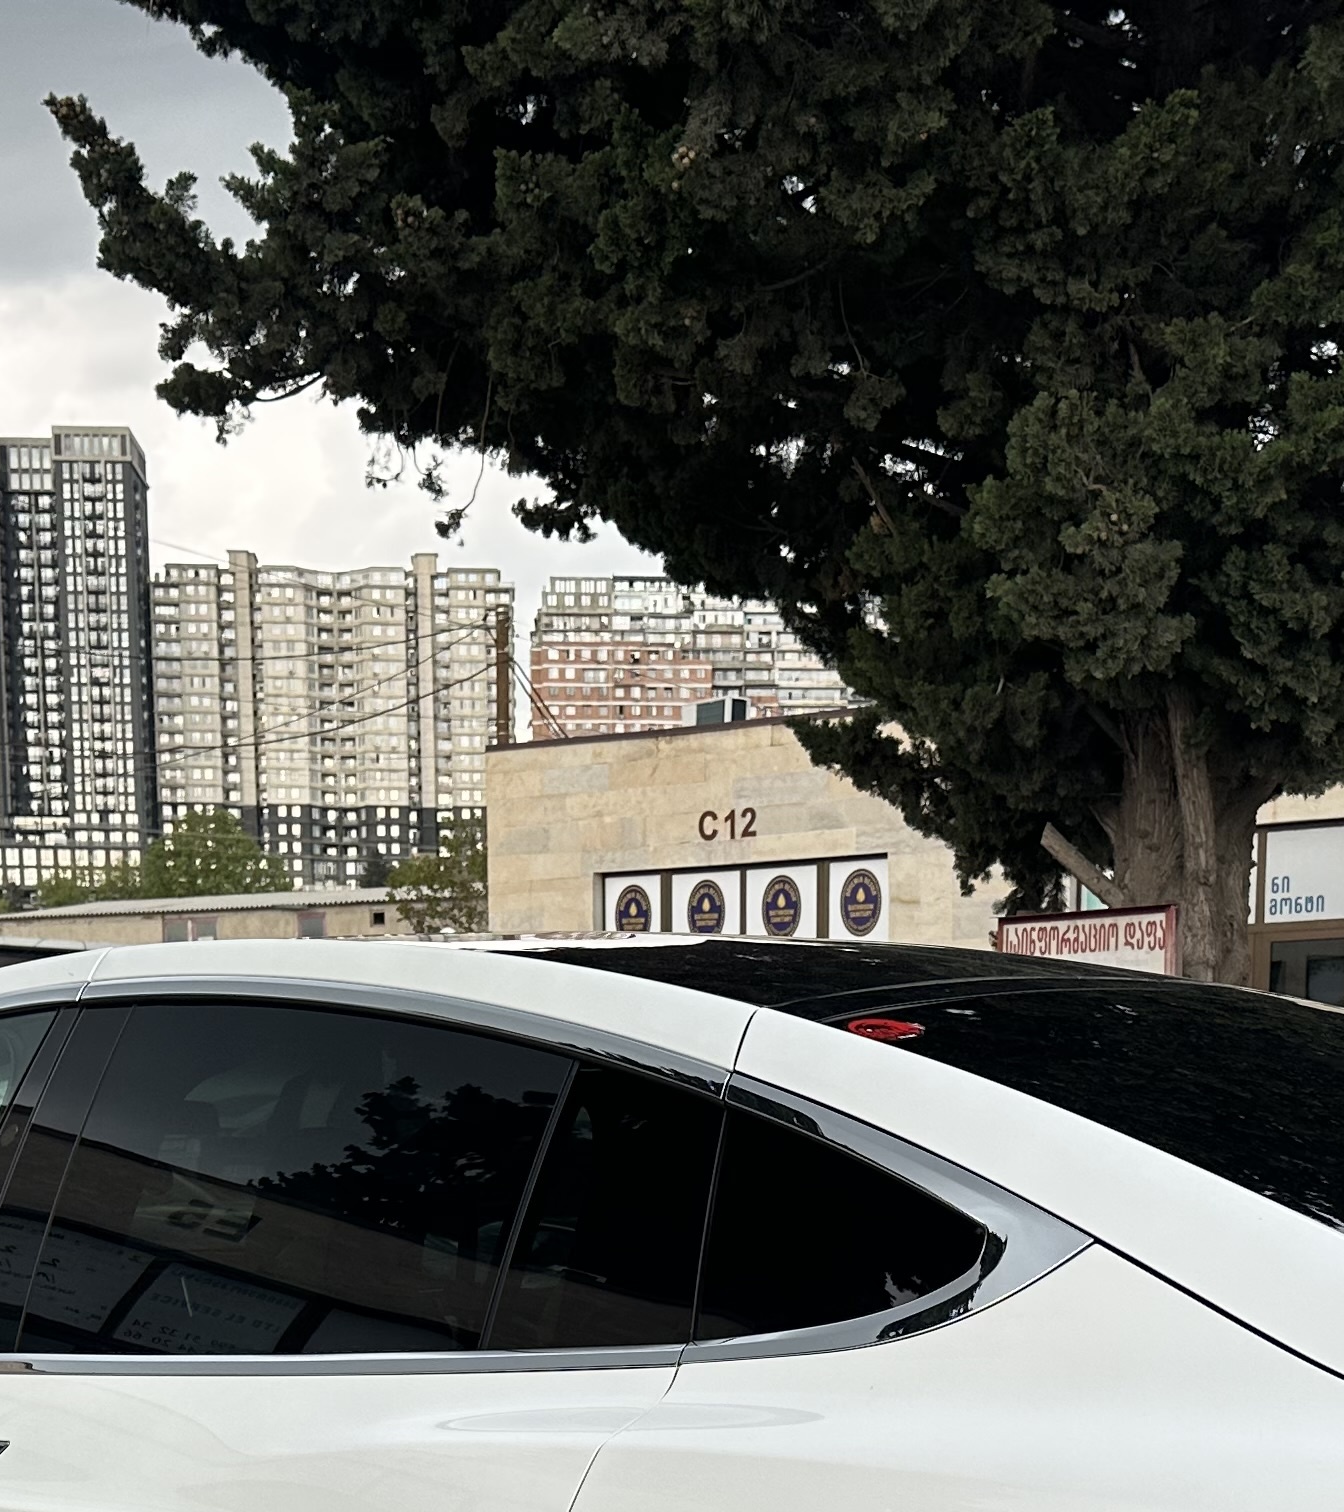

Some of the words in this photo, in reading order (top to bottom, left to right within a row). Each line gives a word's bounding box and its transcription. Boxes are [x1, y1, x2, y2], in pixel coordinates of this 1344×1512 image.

[698, 807, 757, 841] C12
[1269, 895, 1325, 916] მონტი
[1123, 919, 1166, 951] დაფა
